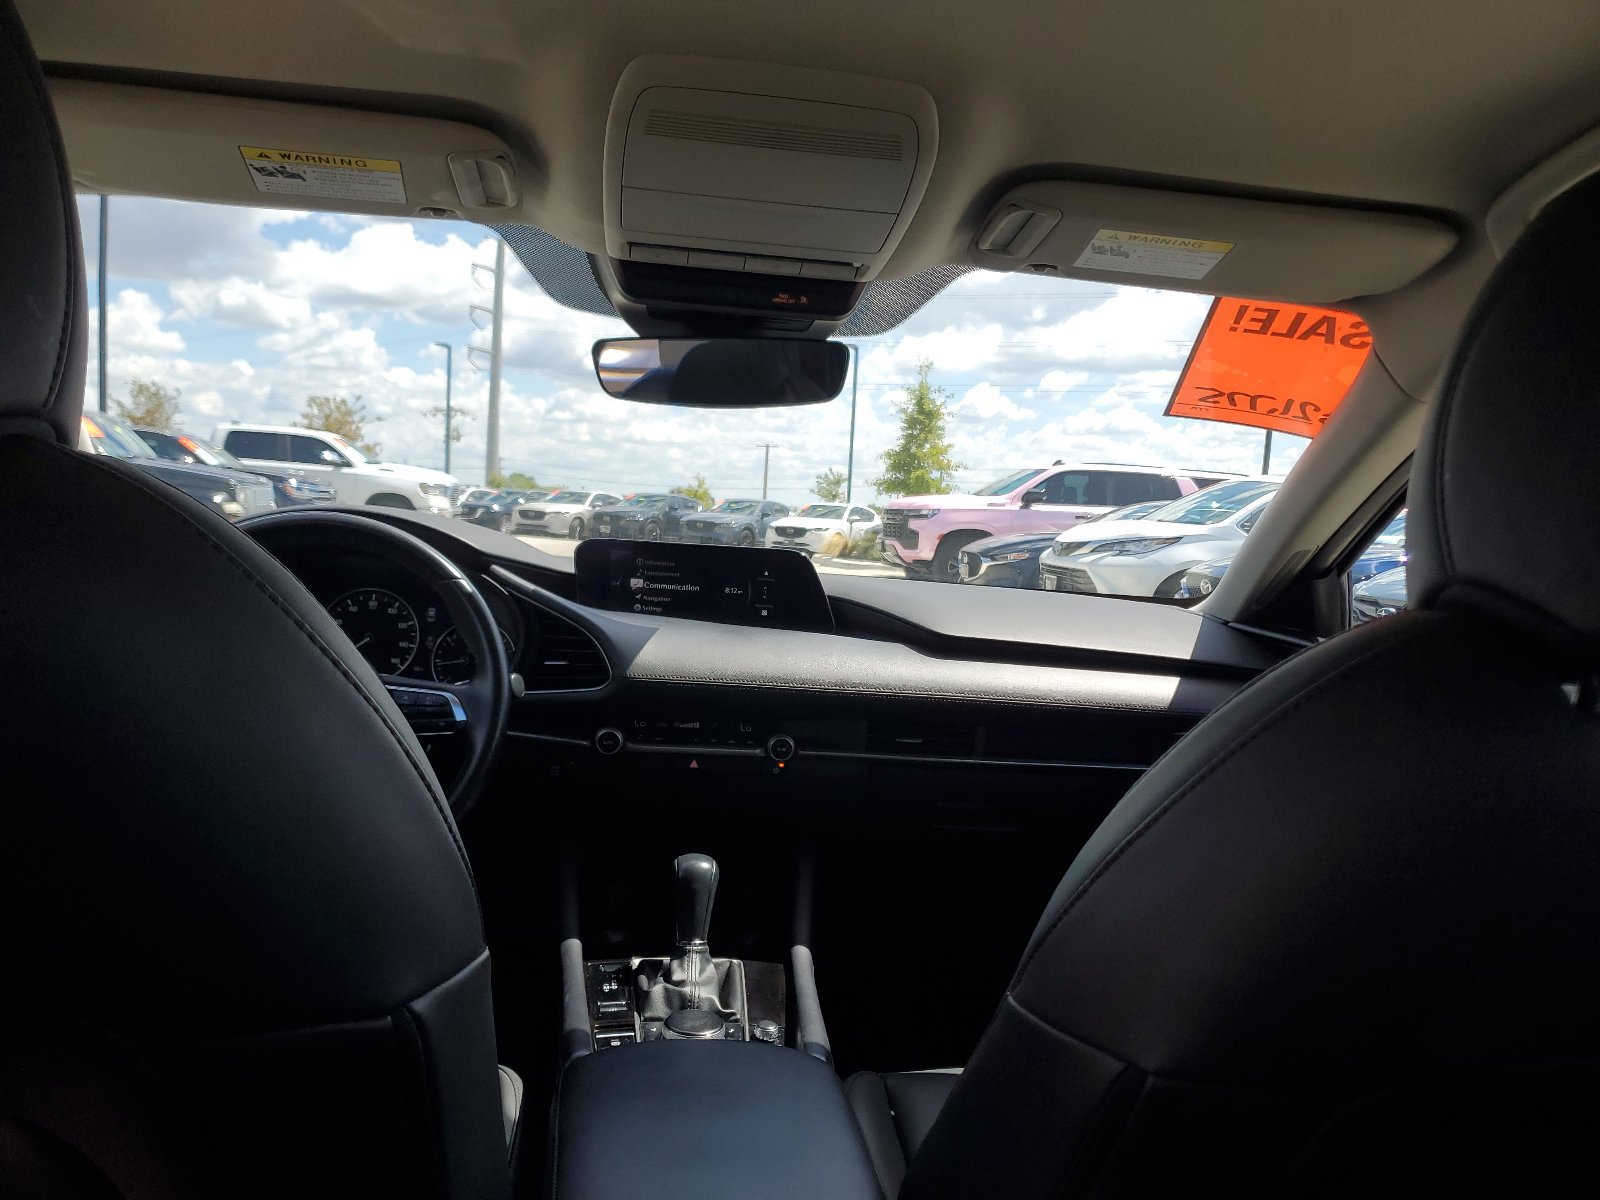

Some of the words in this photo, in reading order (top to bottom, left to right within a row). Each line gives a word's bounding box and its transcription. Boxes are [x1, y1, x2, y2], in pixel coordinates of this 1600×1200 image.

[278, 152, 367, 168] WARNING
[1128, 234, 1204, 249] WARNING
[644, 582, 700, 592] Communication
